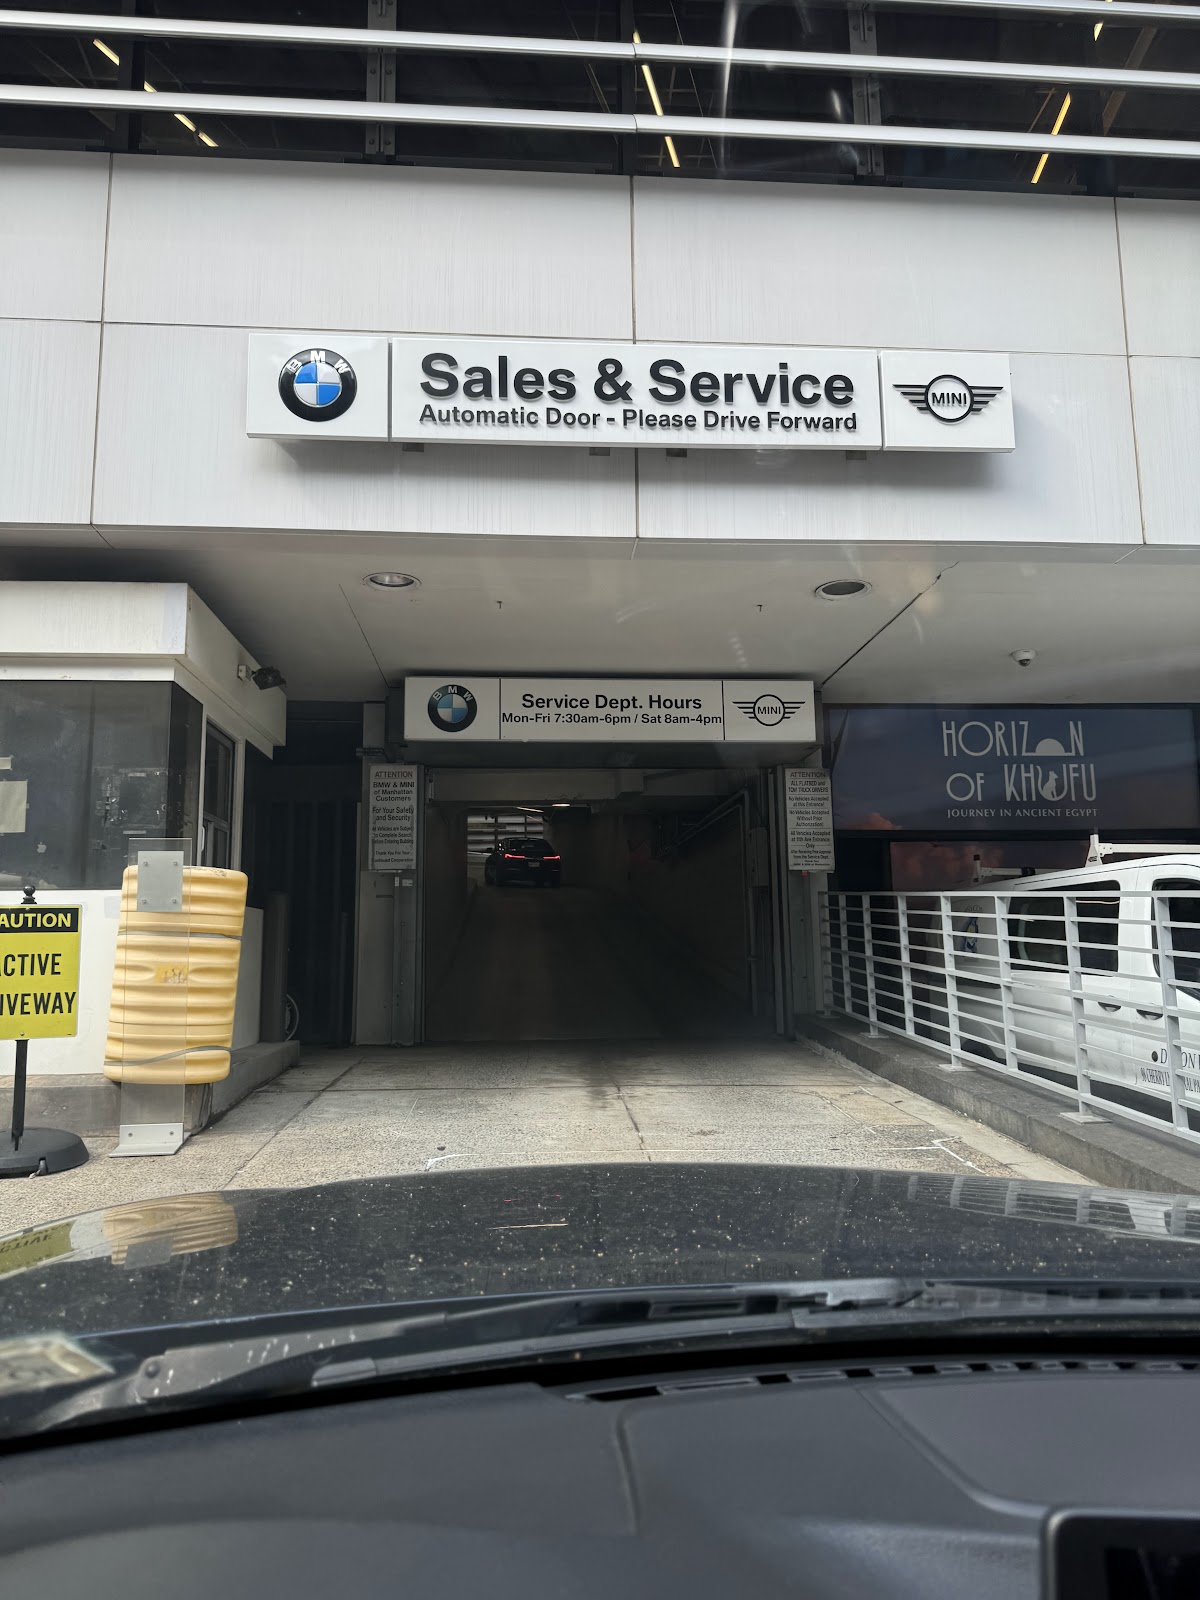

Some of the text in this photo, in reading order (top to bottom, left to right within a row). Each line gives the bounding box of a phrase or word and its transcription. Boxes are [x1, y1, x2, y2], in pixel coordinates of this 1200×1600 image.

[286, 350, 351, 374] BMW
[420, 353, 854, 406] Sales & Service
[932, 393, 967, 405] MINI
[419, 404, 539, 426] Automatic
[546, 407, 600, 428] Door
[623, 409, 697, 429] Please
[703, 411, 760, 431] Drive
[767, 412, 857, 432] Forward
[432, 686, 473, 701] BMW
[521, 693, 702, 712] Service Dept. Hours
[502, 713, 550, 724] Mon-Fri
[554, 713, 631, 726] 7:30am-6pm
[641, 714, 661, 724] Sat
[664, 714, 722, 725] 8am-4pm
[757, 705, 781, 715] MINI
[942, 721, 1084, 757] HORIZON
[946, 773, 985, 801] OF
[1003, 763, 1097, 802] KHUFU
[372, 806, 414, 814] For Your Safety
[947, 808, 1098, 818] JOURNEY IN ANCIENT EGYPT
[0, 912, 72, 928] AUTION
[0, 953, 62, 976] CTIVE
[0, 992, 76, 1016] IVEWAY
